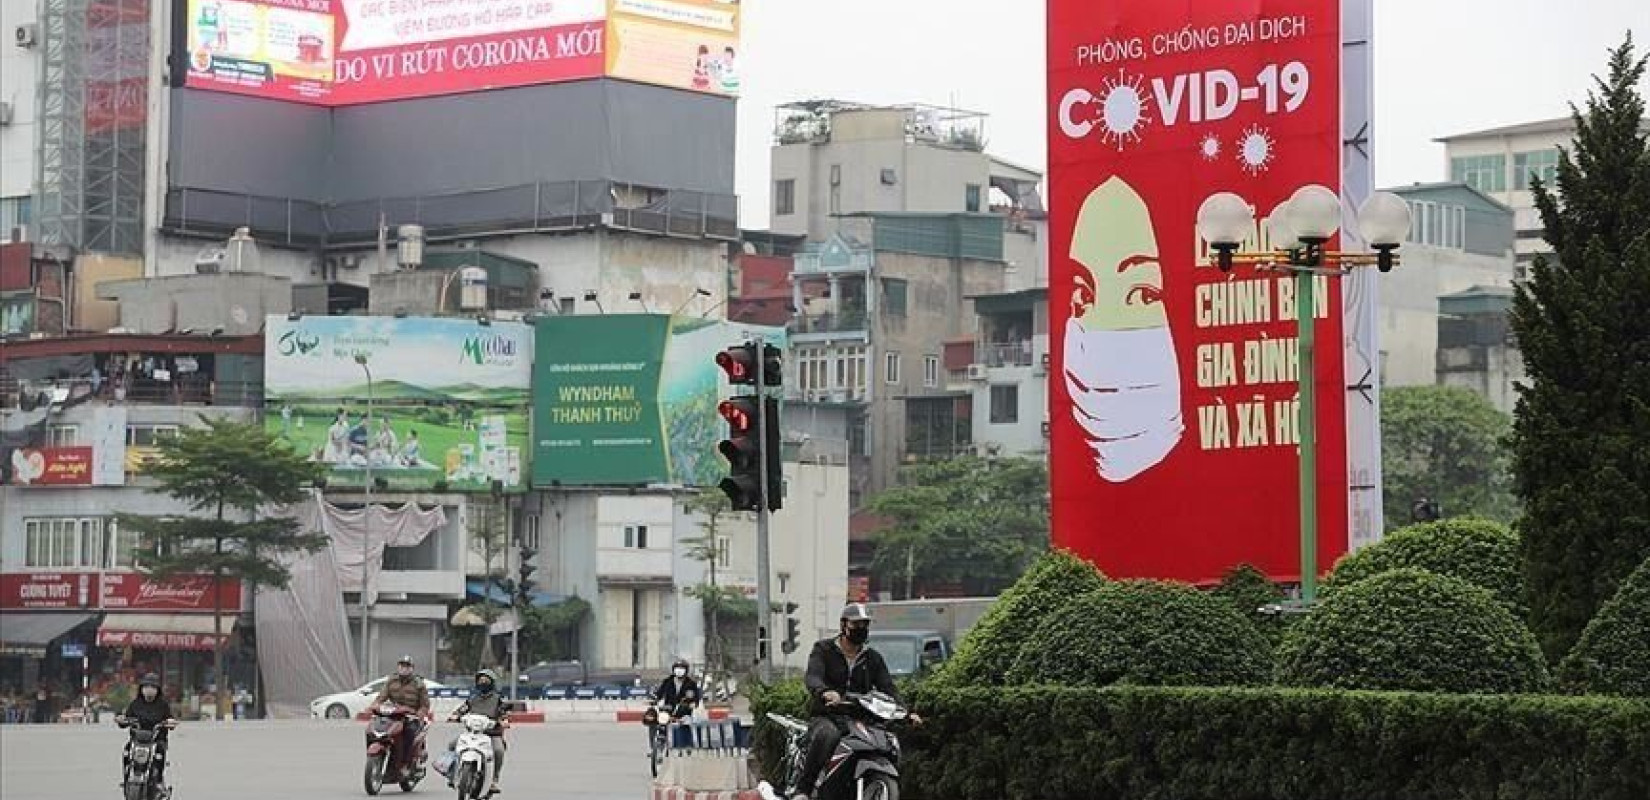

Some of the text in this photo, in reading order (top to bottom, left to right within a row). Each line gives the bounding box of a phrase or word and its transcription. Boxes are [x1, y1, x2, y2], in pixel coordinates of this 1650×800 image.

[335, 27, 604, 84] DO VI RÚT CORONA MỚI
[1077, 16, 1305, 66] PHÒNG, CHỐNG ĐẠI DỊCH
[1195, 273, 1328, 328] CHÍNH BN
[1197, 331, 1300, 388] GIA ĐÌNH
[551, 406, 601, 424] THANH
[558, 384, 635, 401] WYNDHAM
[1198, 395, 1231, 450] VÀ
[1236, 393, 1269, 448] XÃ
